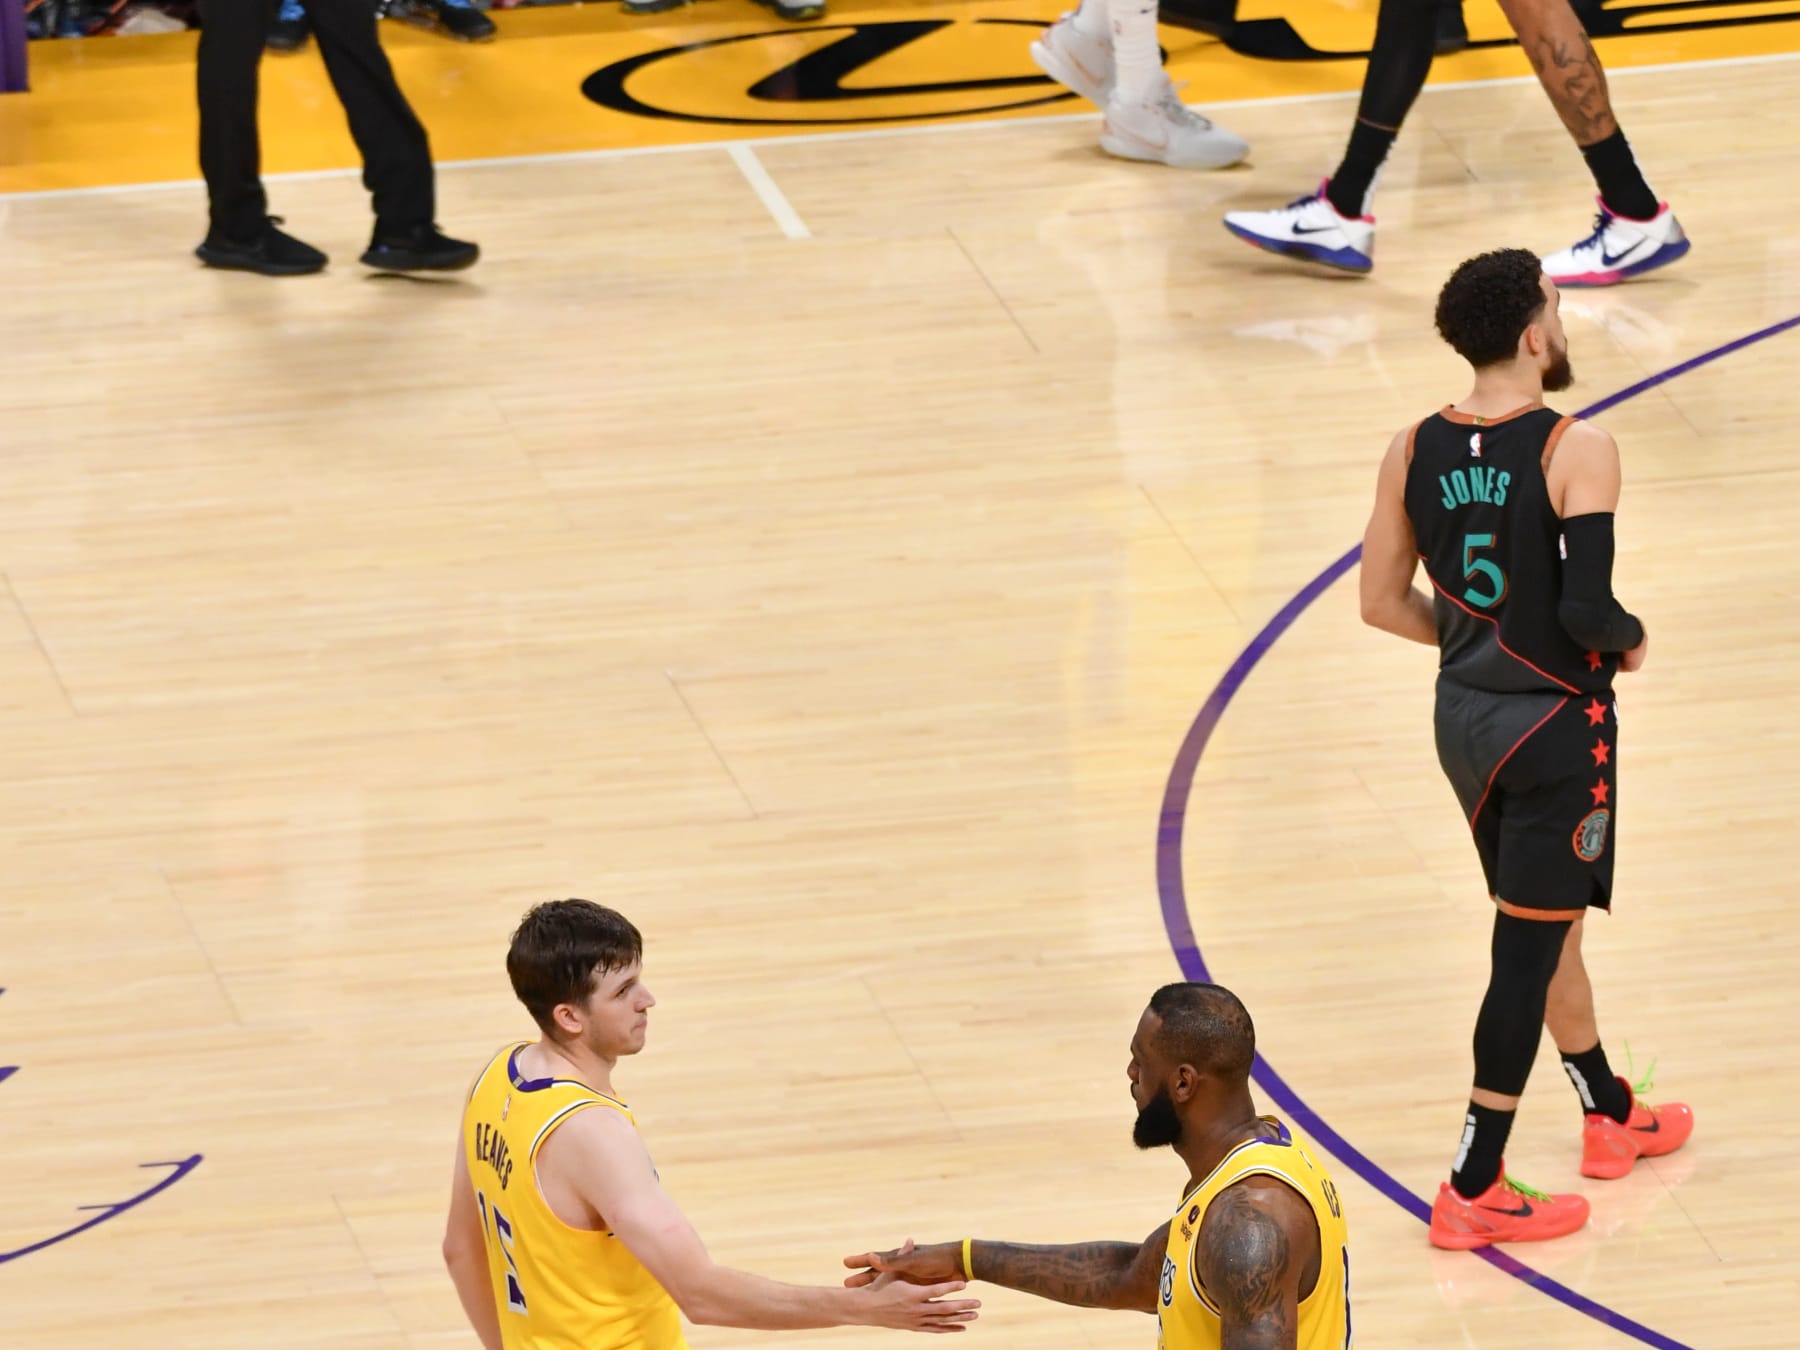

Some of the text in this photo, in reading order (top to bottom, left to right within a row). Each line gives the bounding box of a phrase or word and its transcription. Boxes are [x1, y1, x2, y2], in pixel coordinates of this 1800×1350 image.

[1439, 466, 1511, 510] JONES
[1463, 532, 1509, 608] 5
[476, 1122, 513, 1191] REAVES
